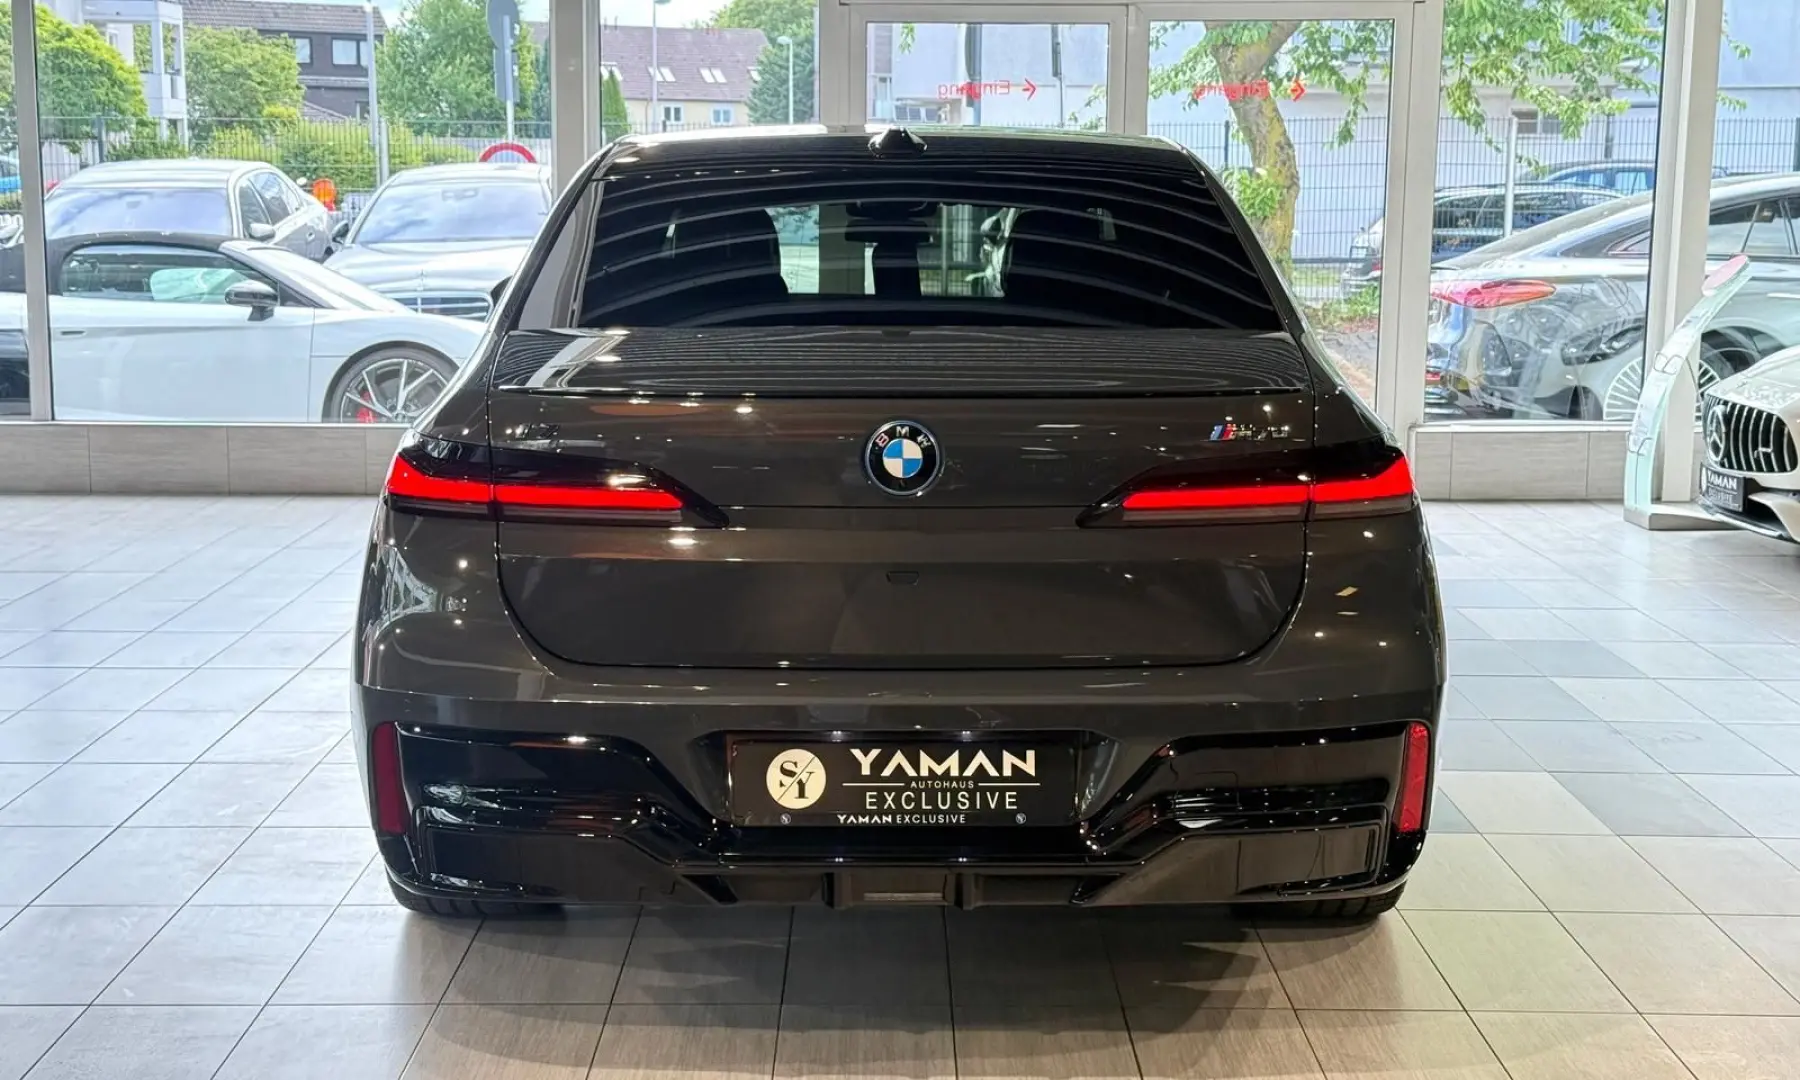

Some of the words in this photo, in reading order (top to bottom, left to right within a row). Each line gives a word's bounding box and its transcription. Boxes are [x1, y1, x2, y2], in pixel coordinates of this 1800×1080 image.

[875, 426, 931, 448] BMW
[850, 749, 1036, 777] YAMAN
[910, 780, 974, 789] AUTOHAUS
[865, 791, 1018, 810] EXCLUSIVE
[837, 814, 892, 824] YAMAN
[896, 814, 966, 824] EXCLUSIVE
